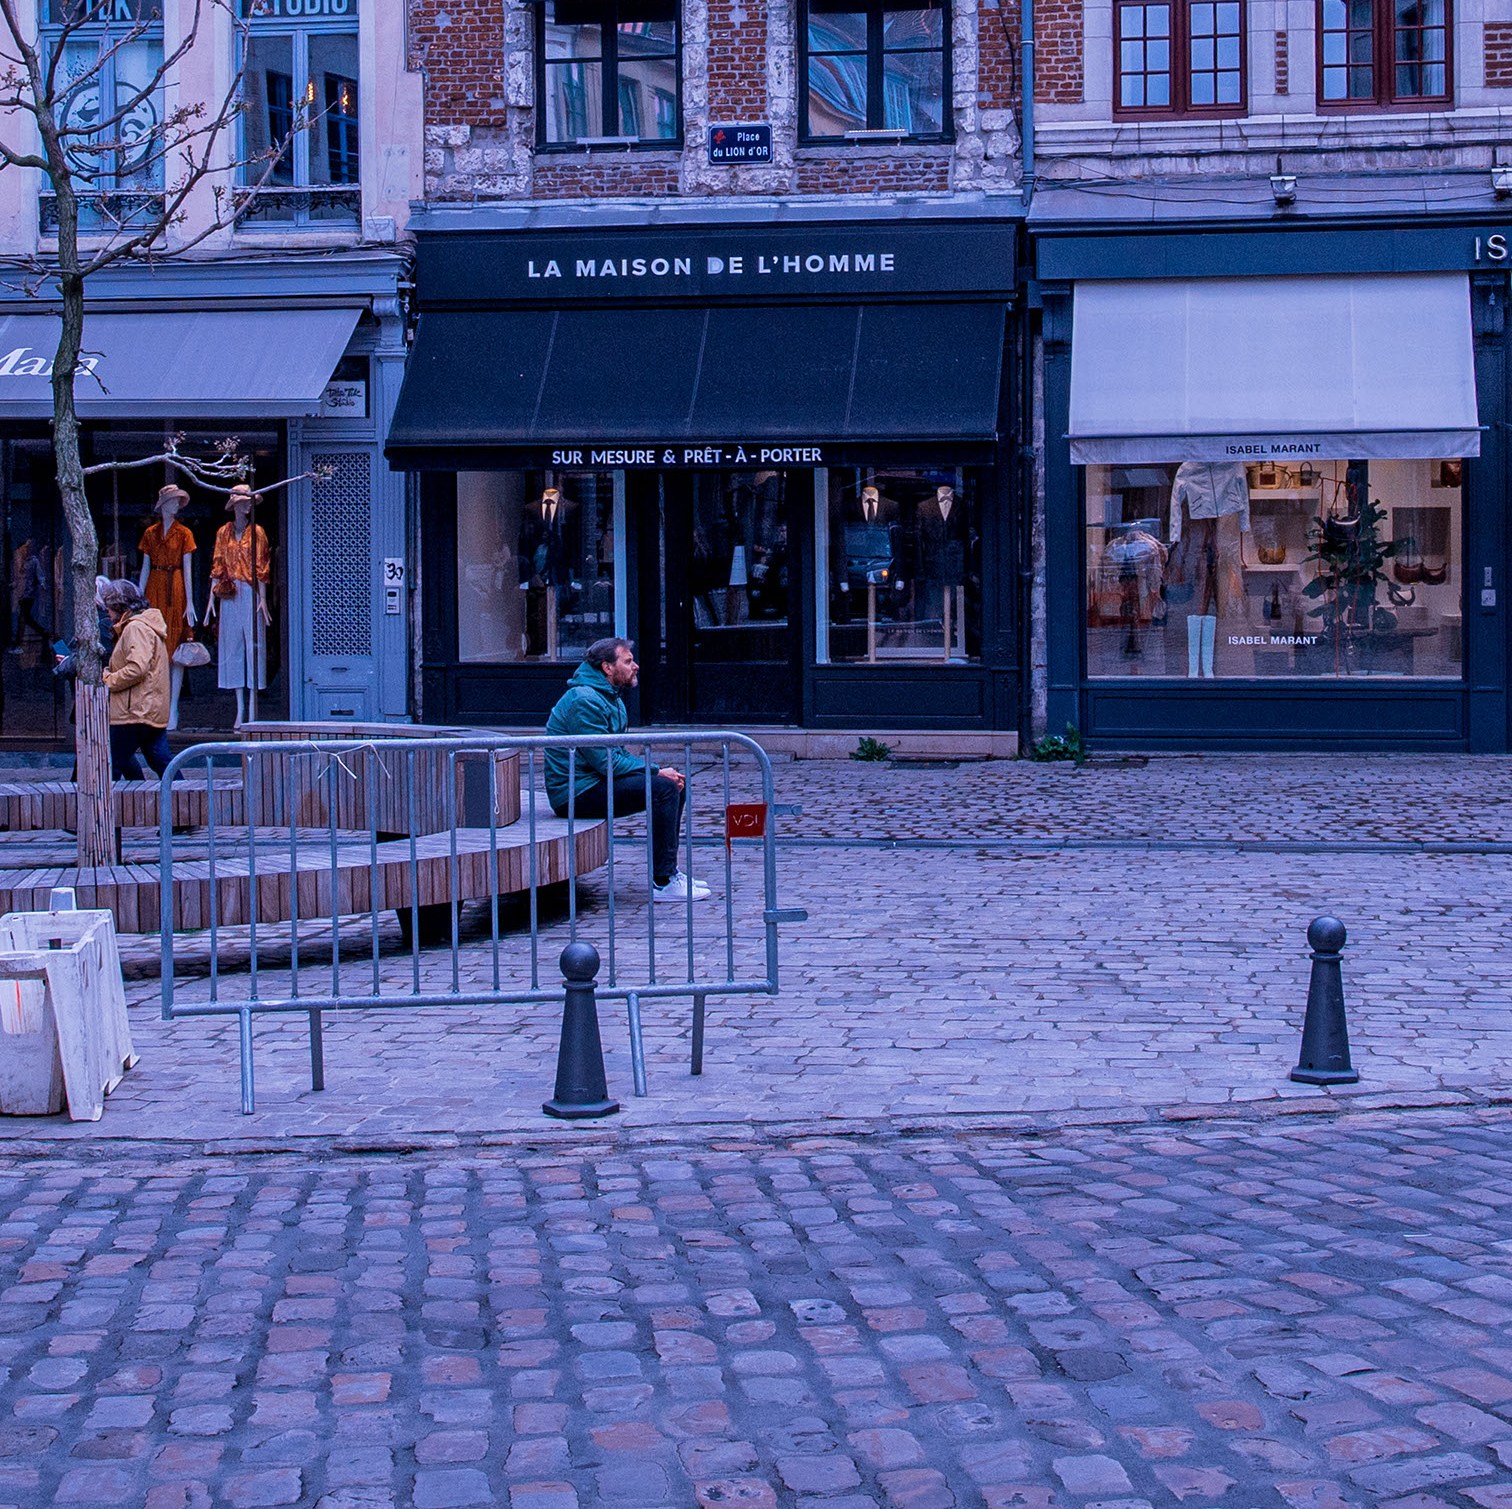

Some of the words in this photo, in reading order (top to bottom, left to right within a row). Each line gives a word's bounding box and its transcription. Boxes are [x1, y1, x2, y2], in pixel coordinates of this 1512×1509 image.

[737, 132, 760, 141] Place
[713, 147, 723, 157] du
[725, 147, 745, 157] LION
[748, 146, 768, 156] d'OR
[528, 260, 562, 278] LA
[576, 257, 691, 277] MAISON
[707, 256, 744, 275] DE
[758, 253, 895, 274] L'HOMME
[1226, 445, 1268, 454] ISABEL
[1271, 444, 1321, 454] MARANT
[552, 450, 583, 464] SUR
[591, 450, 655, 464] MESURE
[663, 450, 676, 464] &
[1228, 635, 1267, 645] ISABEL
[1270, 635, 1318, 645] MARANT
